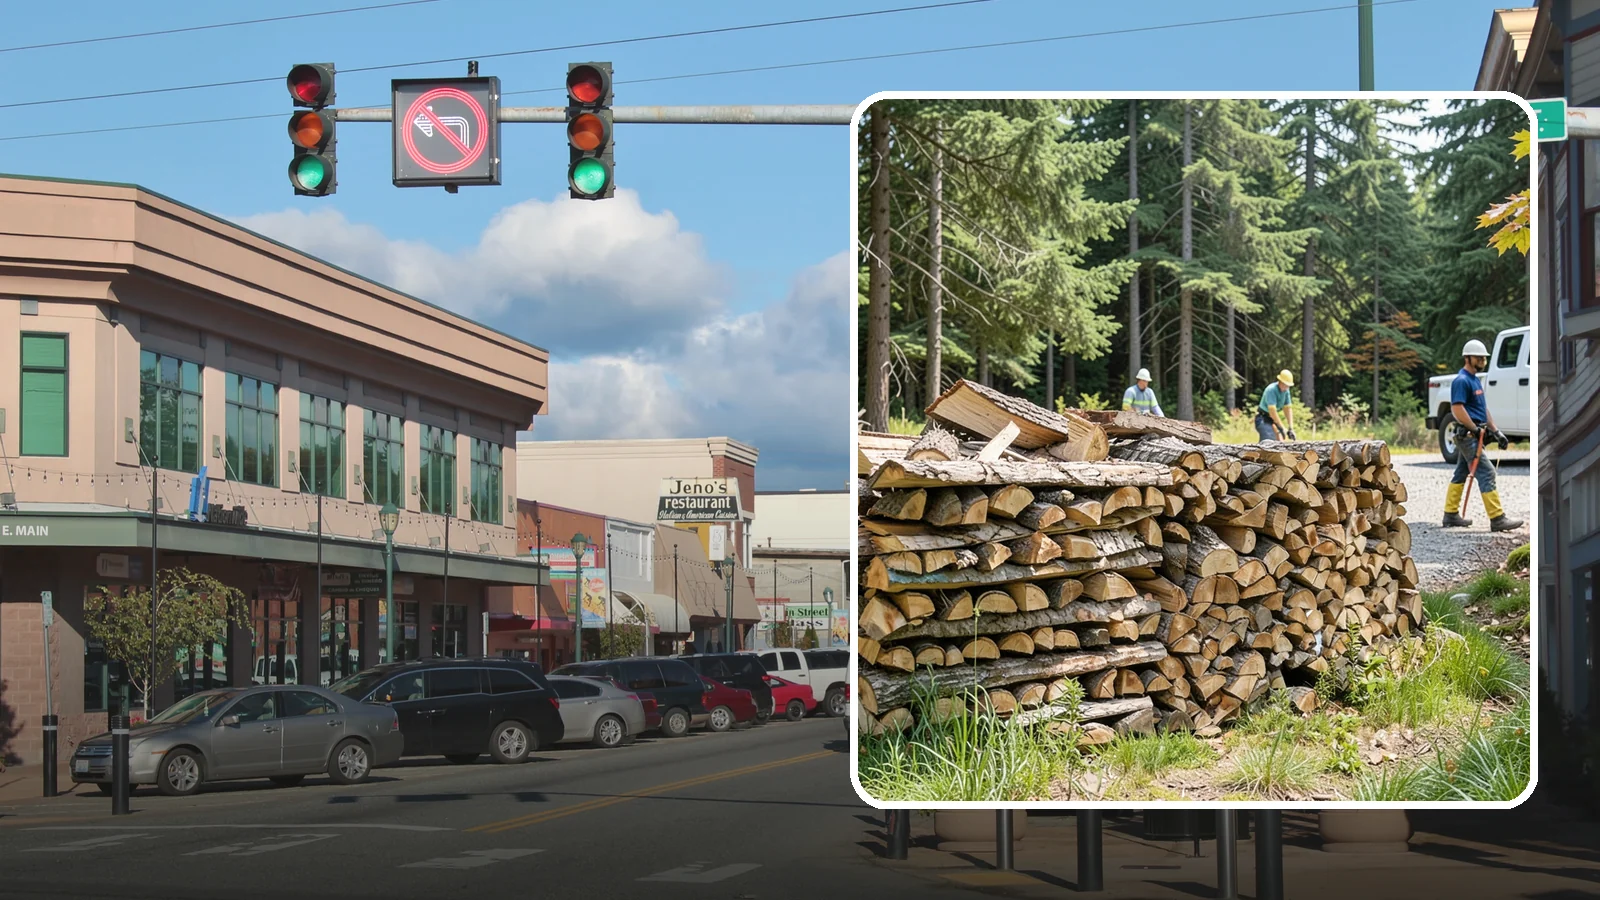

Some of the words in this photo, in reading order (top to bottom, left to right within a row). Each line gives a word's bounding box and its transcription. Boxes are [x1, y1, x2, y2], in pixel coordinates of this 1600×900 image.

[670, 480, 727, 494] Jeno's
[665, 497, 731, 509] restaurant
[659, 510, 681, 519] Italian
[686, 510, 714, 519] American
[715, 510, 737, 519] Cuisine
[2, 525, 13, 536] E.
[15, 525, 49, 536] MAIN
[797, 607, 828, 616] Street
[791, 619, 823, 627] lass
